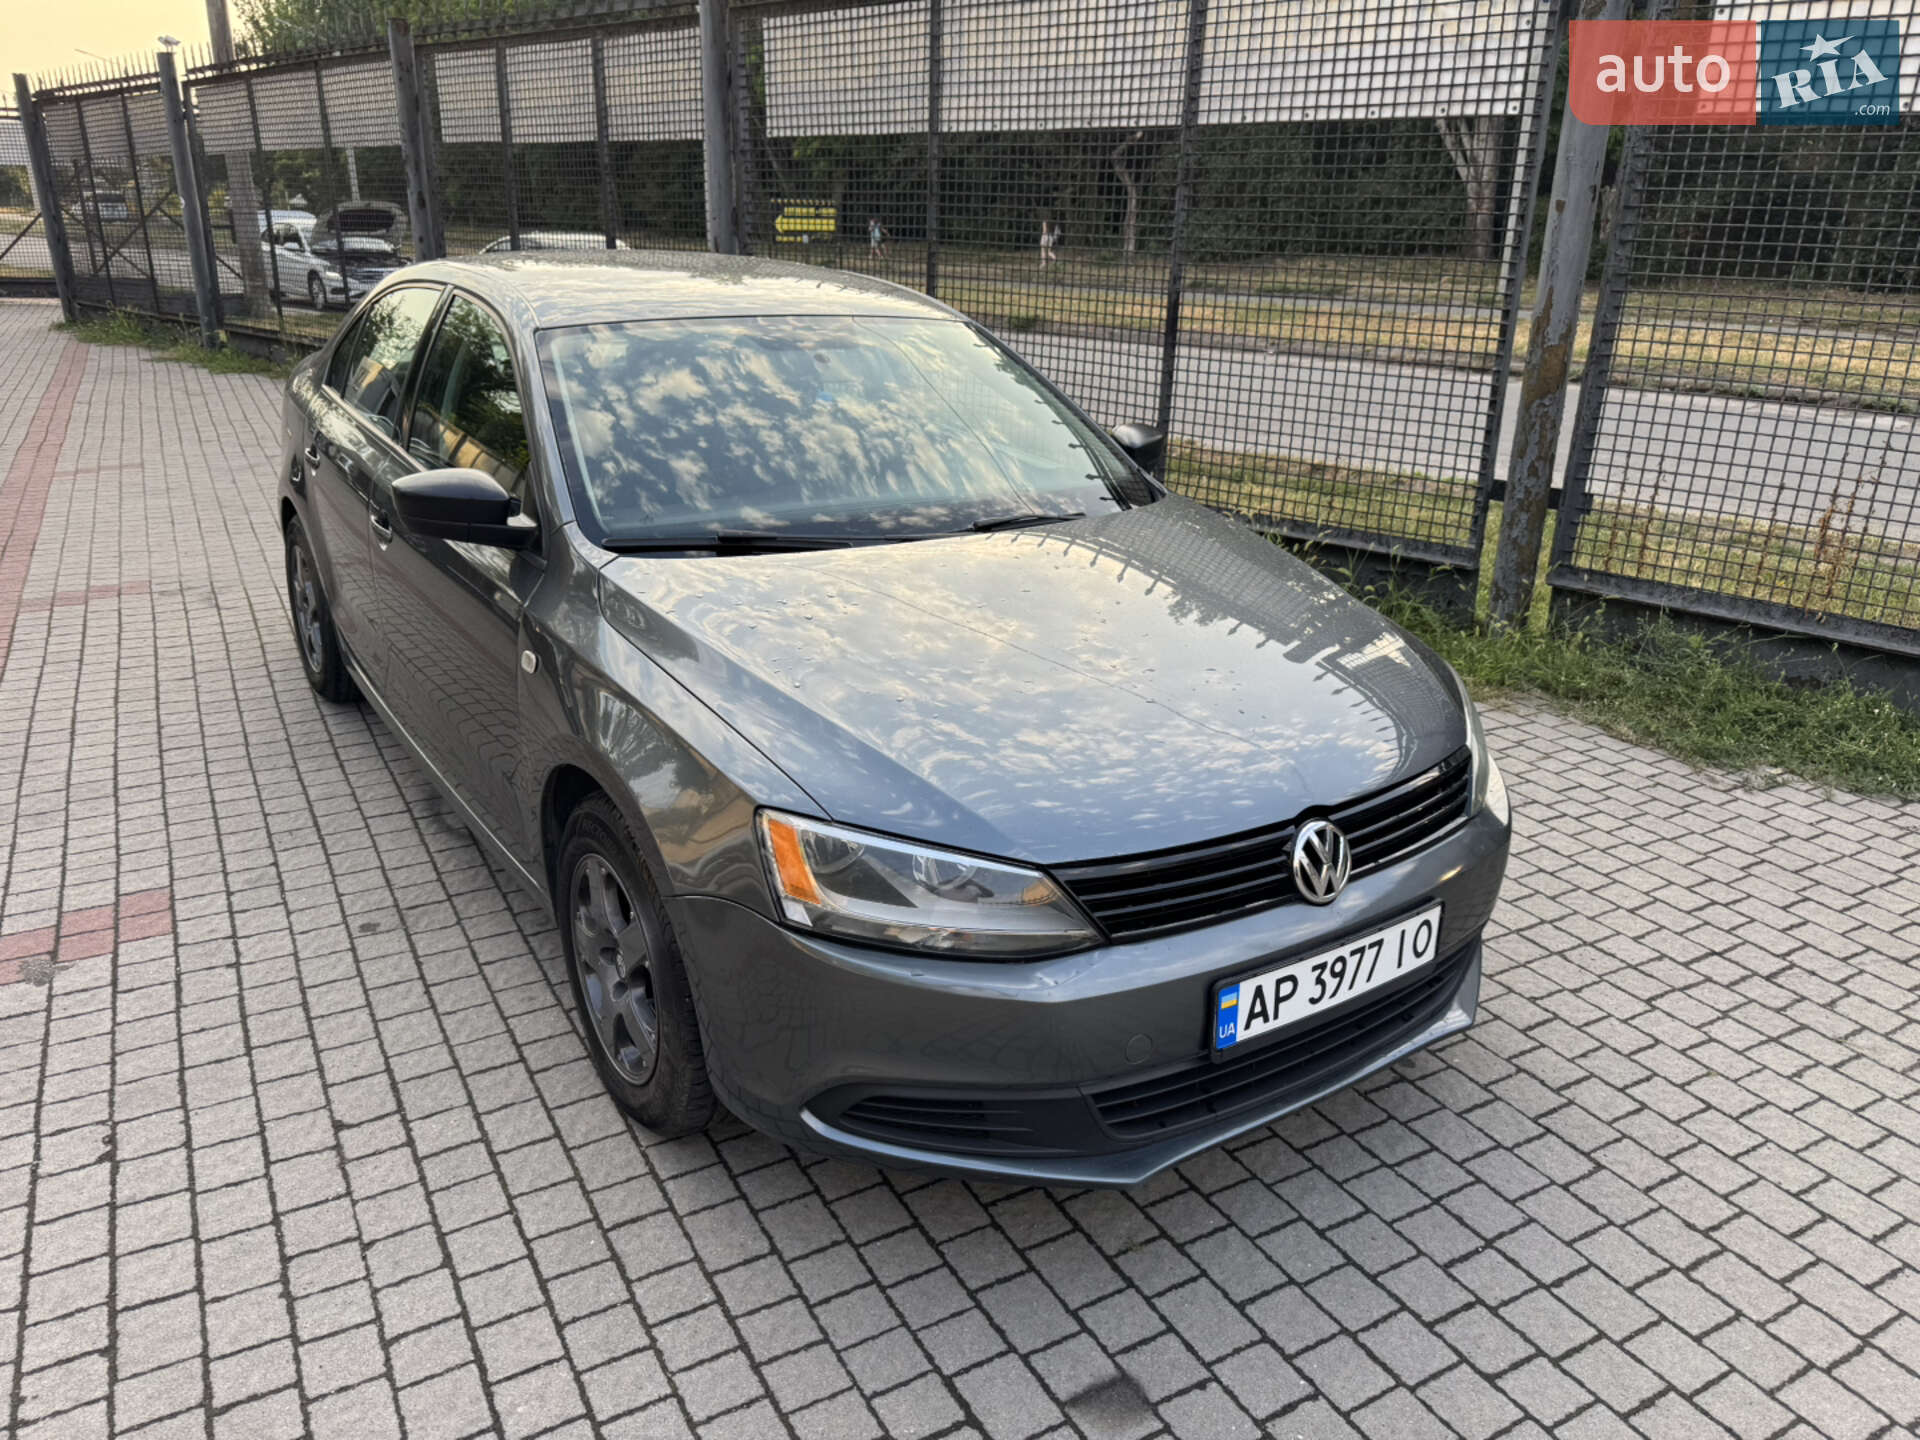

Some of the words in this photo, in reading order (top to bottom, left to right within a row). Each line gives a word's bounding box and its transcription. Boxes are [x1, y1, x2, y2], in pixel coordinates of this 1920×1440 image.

[1243, 973, 1299, 1031] AP
[1308, 938, 1385, 1006] 3977
[1397, 919, 1433, 969] IO
[1219, 1021, 1236, 1039] UA
